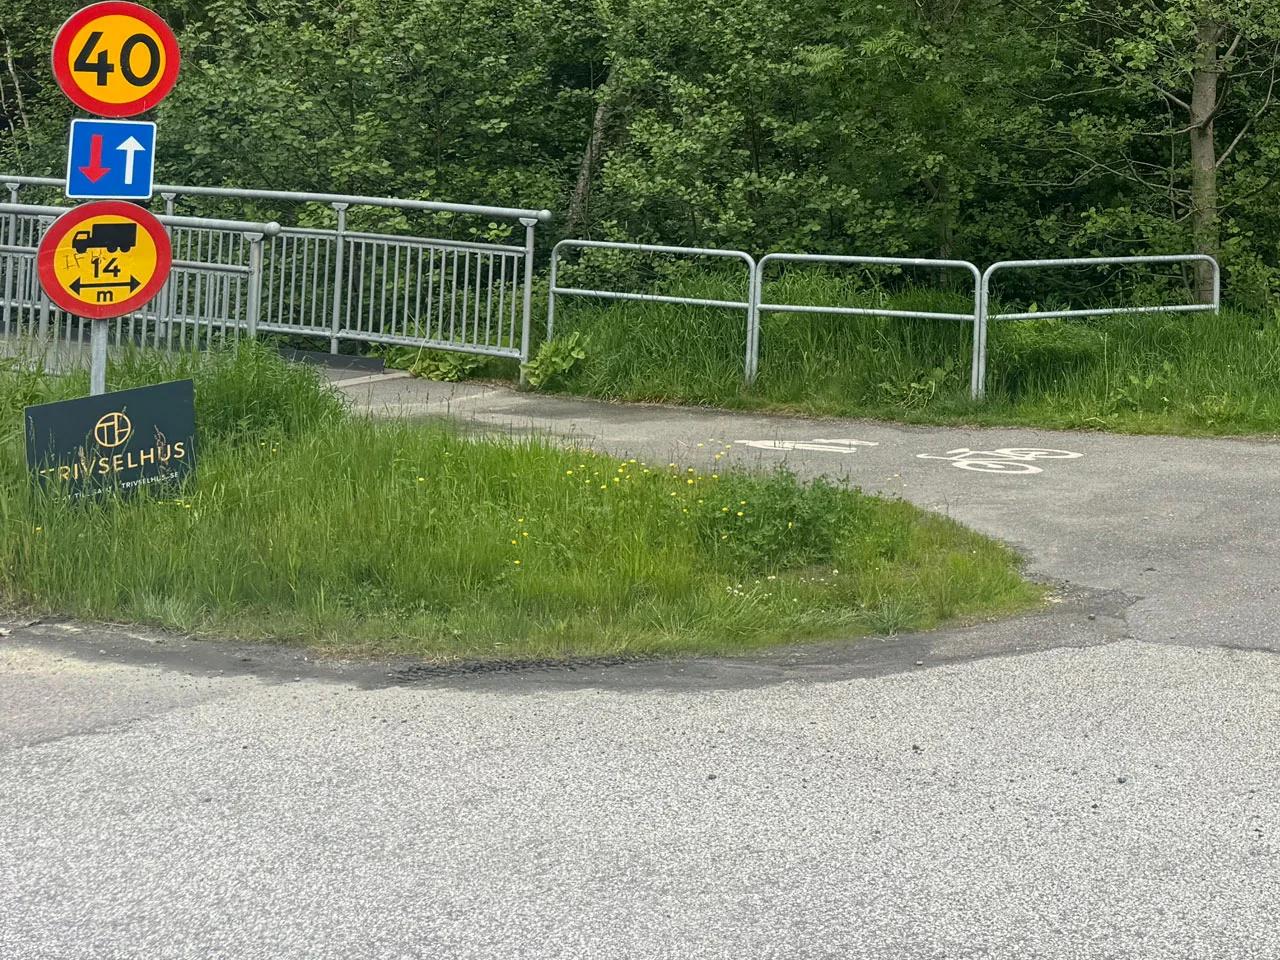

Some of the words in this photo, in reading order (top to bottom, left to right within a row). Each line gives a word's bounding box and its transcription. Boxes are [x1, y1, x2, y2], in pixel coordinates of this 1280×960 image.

[73, 31, 161, 87] 40
[91, 257, 121, 278] 14
[96, 290, 114, 302] m
